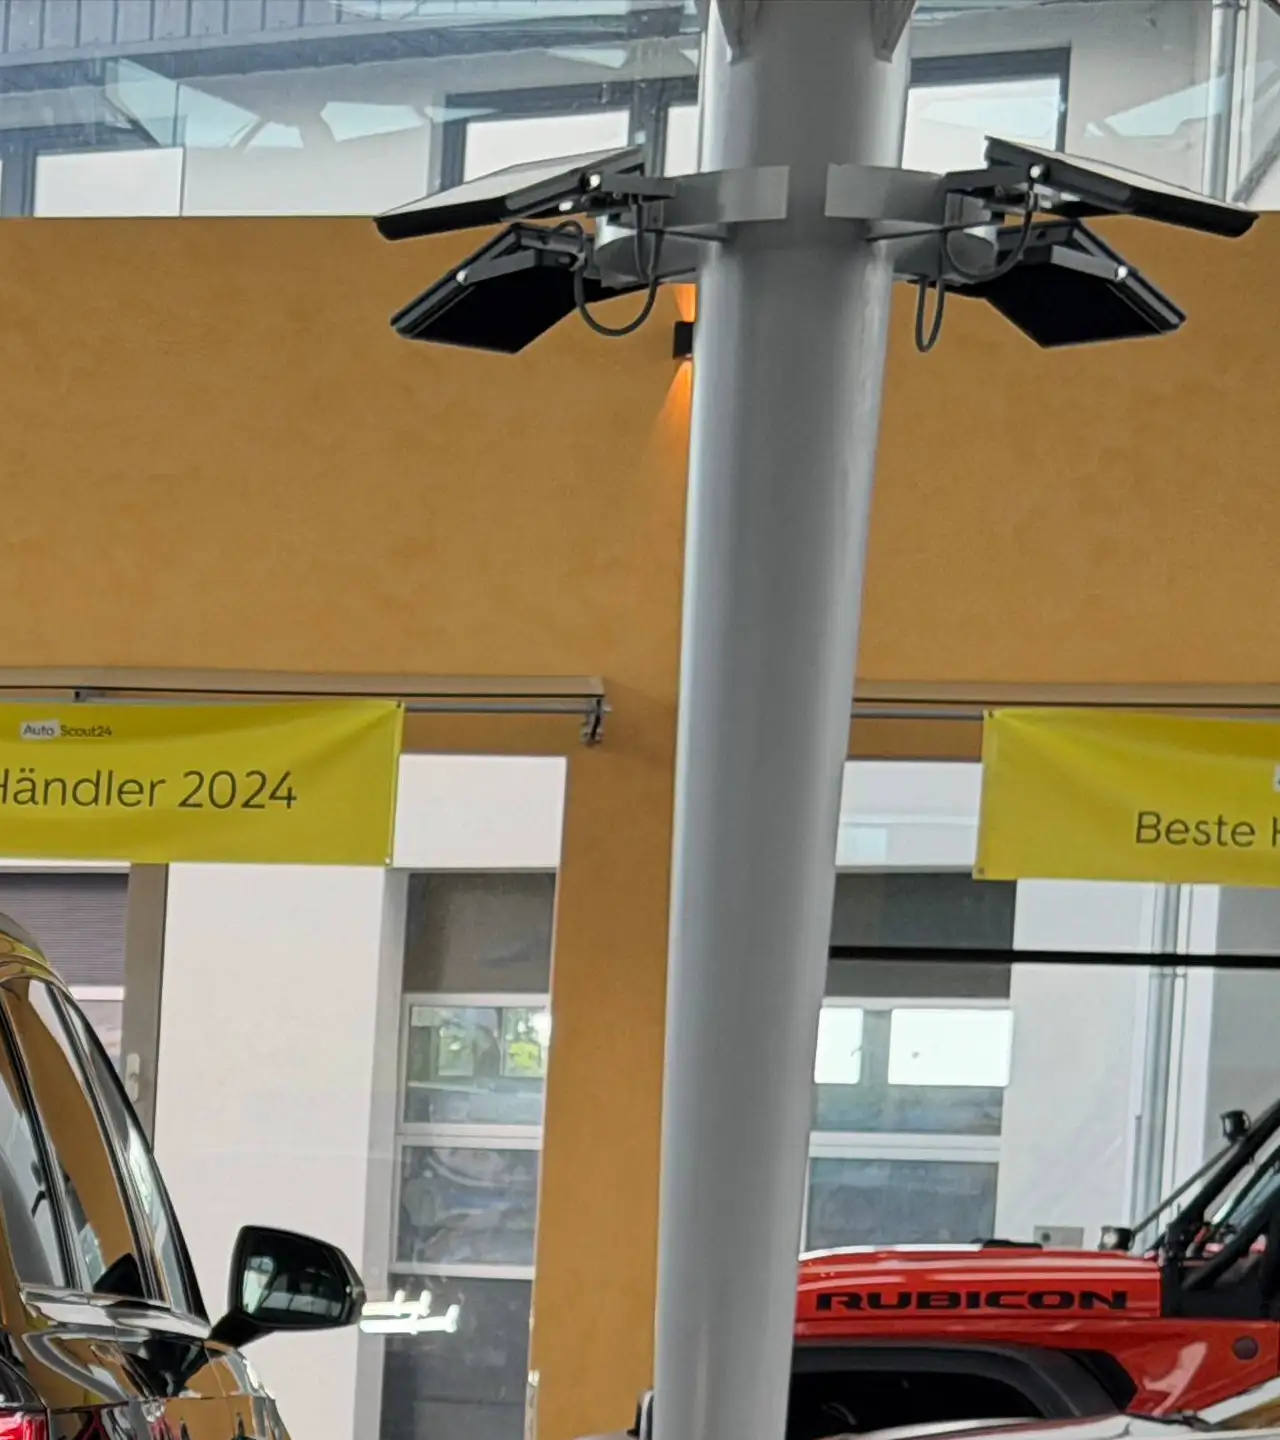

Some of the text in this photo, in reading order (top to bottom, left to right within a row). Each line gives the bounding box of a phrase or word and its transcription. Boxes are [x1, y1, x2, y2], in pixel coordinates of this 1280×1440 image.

[178, 769, 299, 811] 2024
[1135, 810, 1257, 848] Beste
[815, 1289, 1128, 1313] RUBICON
